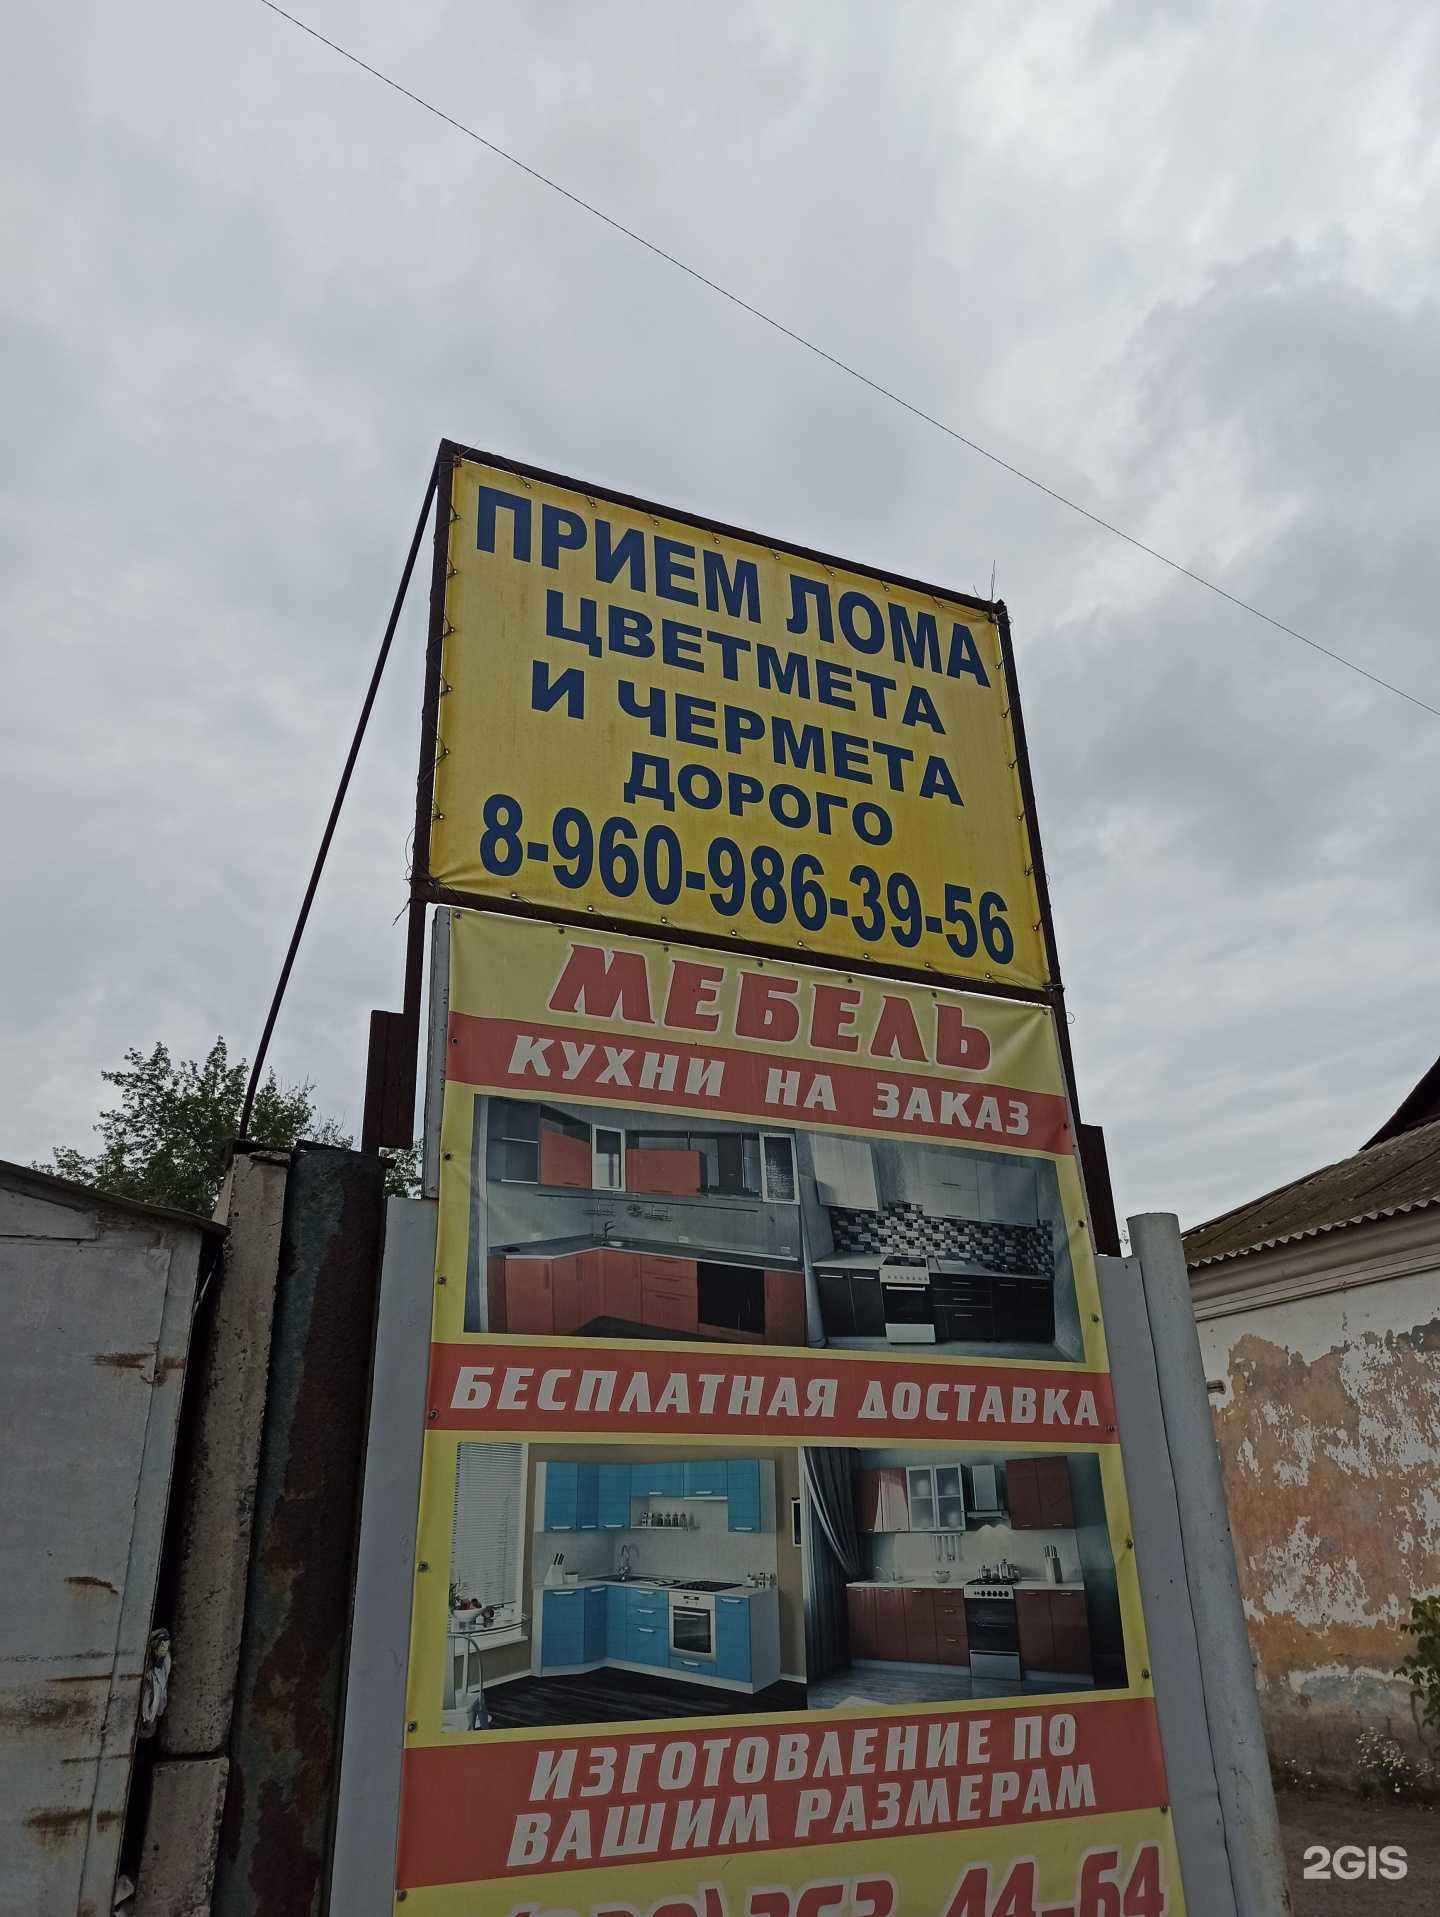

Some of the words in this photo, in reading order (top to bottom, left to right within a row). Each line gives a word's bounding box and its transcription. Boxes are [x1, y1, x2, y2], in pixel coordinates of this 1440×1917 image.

[476, 486, 761, 623] ПРИЕМ
[786, 574, 991, 689] ЛОМА
[546, 589, 946, 735] ЦВЕТМЕТА
[531, 660, 585, 720] И
[618, 680, 963, 807] ЧЕРМЕТА
[623, 751, 893, 846] ДОРОГО
[480, 794, 1015, 965] 8-960-986-39-56
[548, 944, 991, 1071] МЕБЕЛЬ
[506, 1034, 726, 1097] КУХНИ
[764, 1068, 838, 1112] НА
[872, 1082, 1030, 1137] ЗАКАЗ
[450, 1365, 839, 1418] БЕСПЛАТНАЯ
[857, 1380, 1101, 1426] ДОСТАВКА
[506, 1793, 770, 1867] ВАШИМ
[794, 1763, 1097, 1838] РАЗМЕРАМ
[529, 1719, 994, 1802] ИЗГОТОВЛЕНИЕ
[1013, 1713, 1077, 1757] ПО
